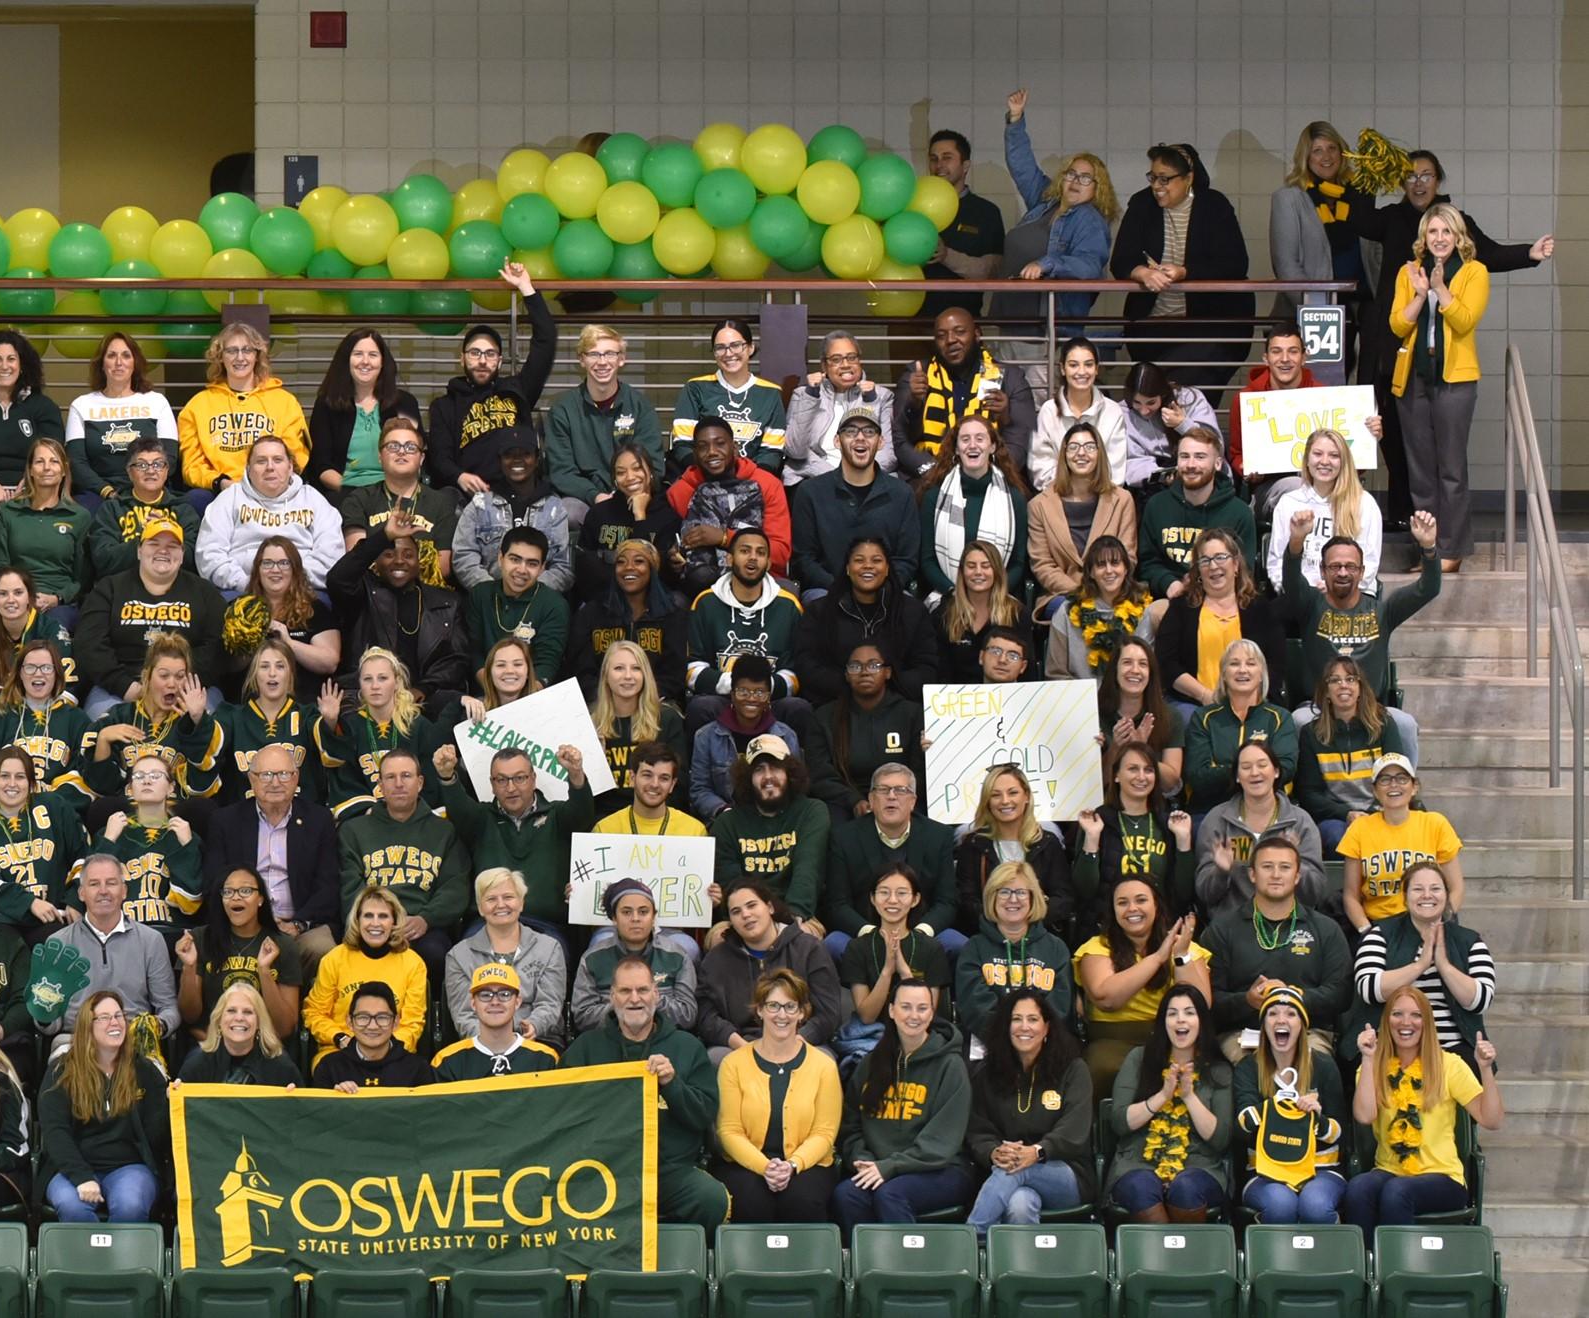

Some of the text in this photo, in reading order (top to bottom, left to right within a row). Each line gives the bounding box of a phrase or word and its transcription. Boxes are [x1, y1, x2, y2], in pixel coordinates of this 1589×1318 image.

[1303, 312, 1339, 322] SECTION
[1303, 326, 1339, 356] 54
[88, 405, 152, 420] LAKERS
[1247, 397, 1268, 422] I
[209, 412, 276, 434] OSWEGO
[1268, 407, 1350, 444] LOVE
[239, 503, 282, 528] OSWEGO
[120, 603, 192, 623] OSWEGO
[61, 657, 79, 683] 2
[931, 690, 1004, 719] GREEN
[996, 716, 1007, 744] &
[32, 804, 51, 830] C
[362, 845, 443, 878] OSWEGO
[628, 843, 664, 871] AM
[138, 872, 162, 900] 10
[366, 867, 434, 892] STATE
[593, 873, 703, 918] LER
[477, 968, 509, 982] OSWEGO
[291, 1158, 617, 1237] OSWEGO
[95, 1235, 108, 1246] 11
[298, 1226, 617, 1255] STATE UNIVERSITY OF NEW YORK
